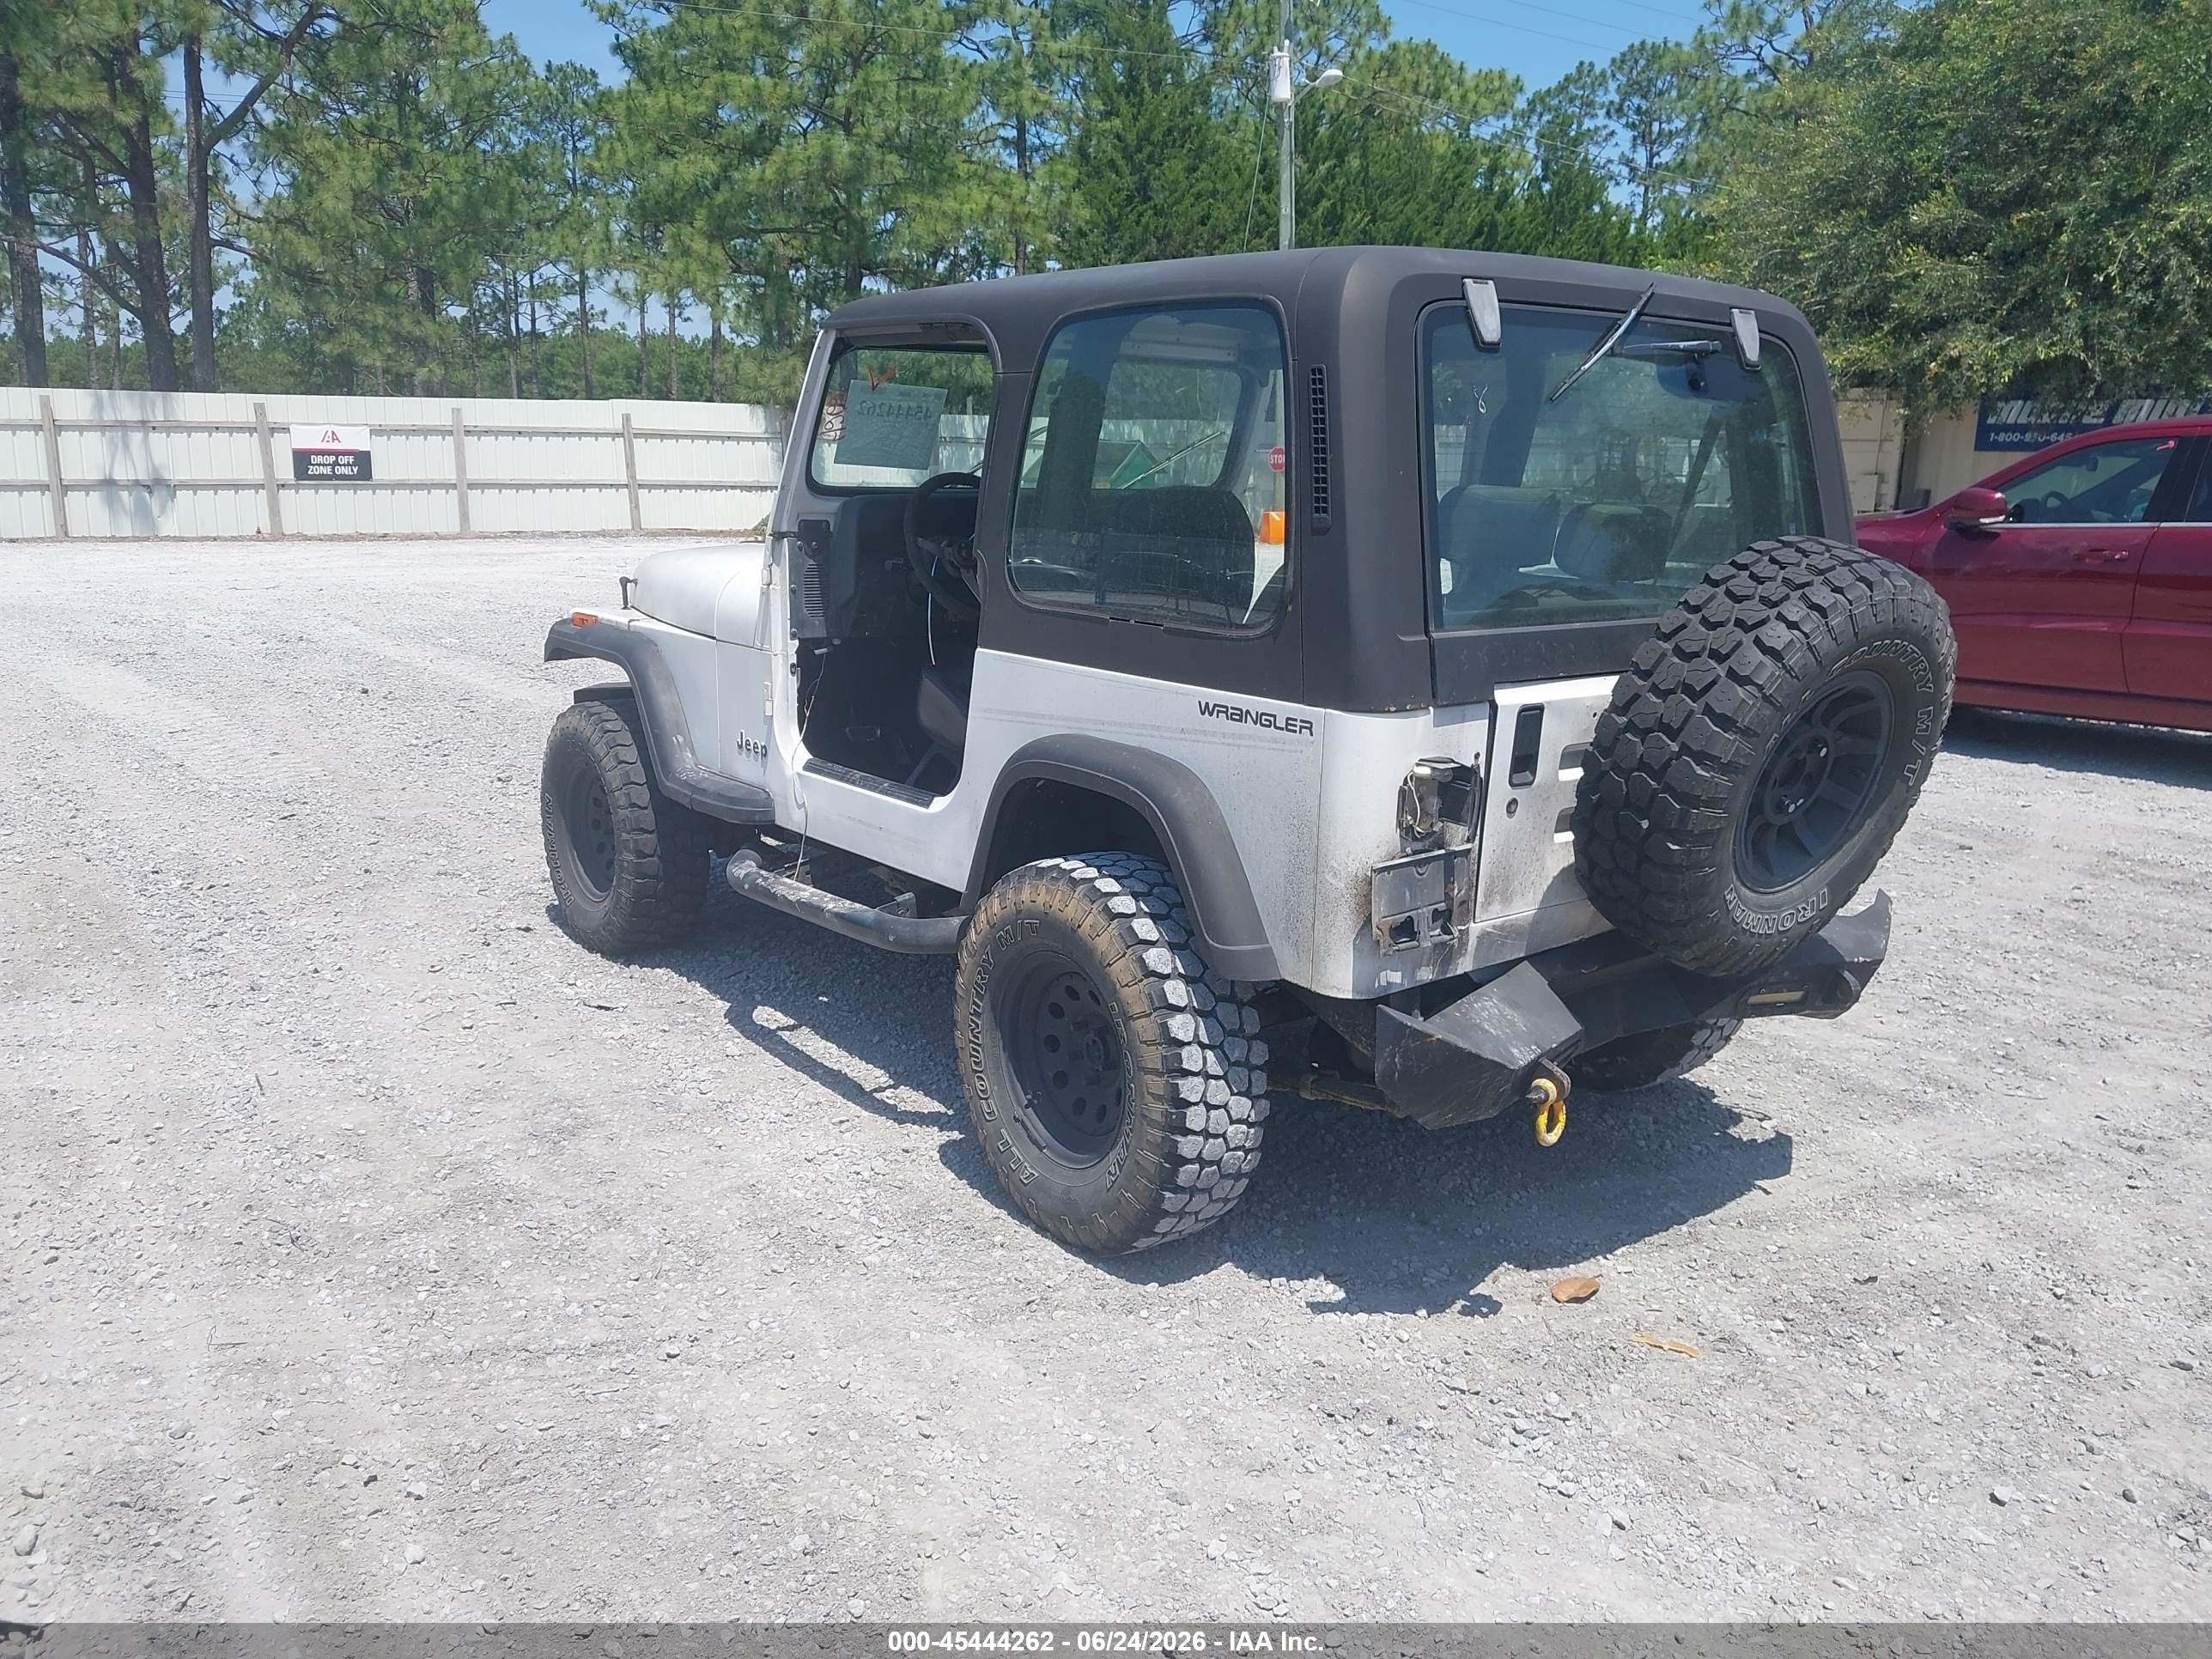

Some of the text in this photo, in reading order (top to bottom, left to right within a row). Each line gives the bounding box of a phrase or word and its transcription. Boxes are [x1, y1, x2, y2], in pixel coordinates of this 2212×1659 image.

[307, 465, 358, 475] ZONE ONLY
[311, 455, 355, 465] DROP OFF
[1825, 640, 1934, 693] COUNTRY
[1904, 706, 1934, 786] M/T
[736, 731, 768, 763] Jeep
[1724, 884, 1828, 934] IRONMAN
[968, 919, 1040, 1186] ALL COUNTRY M/T
